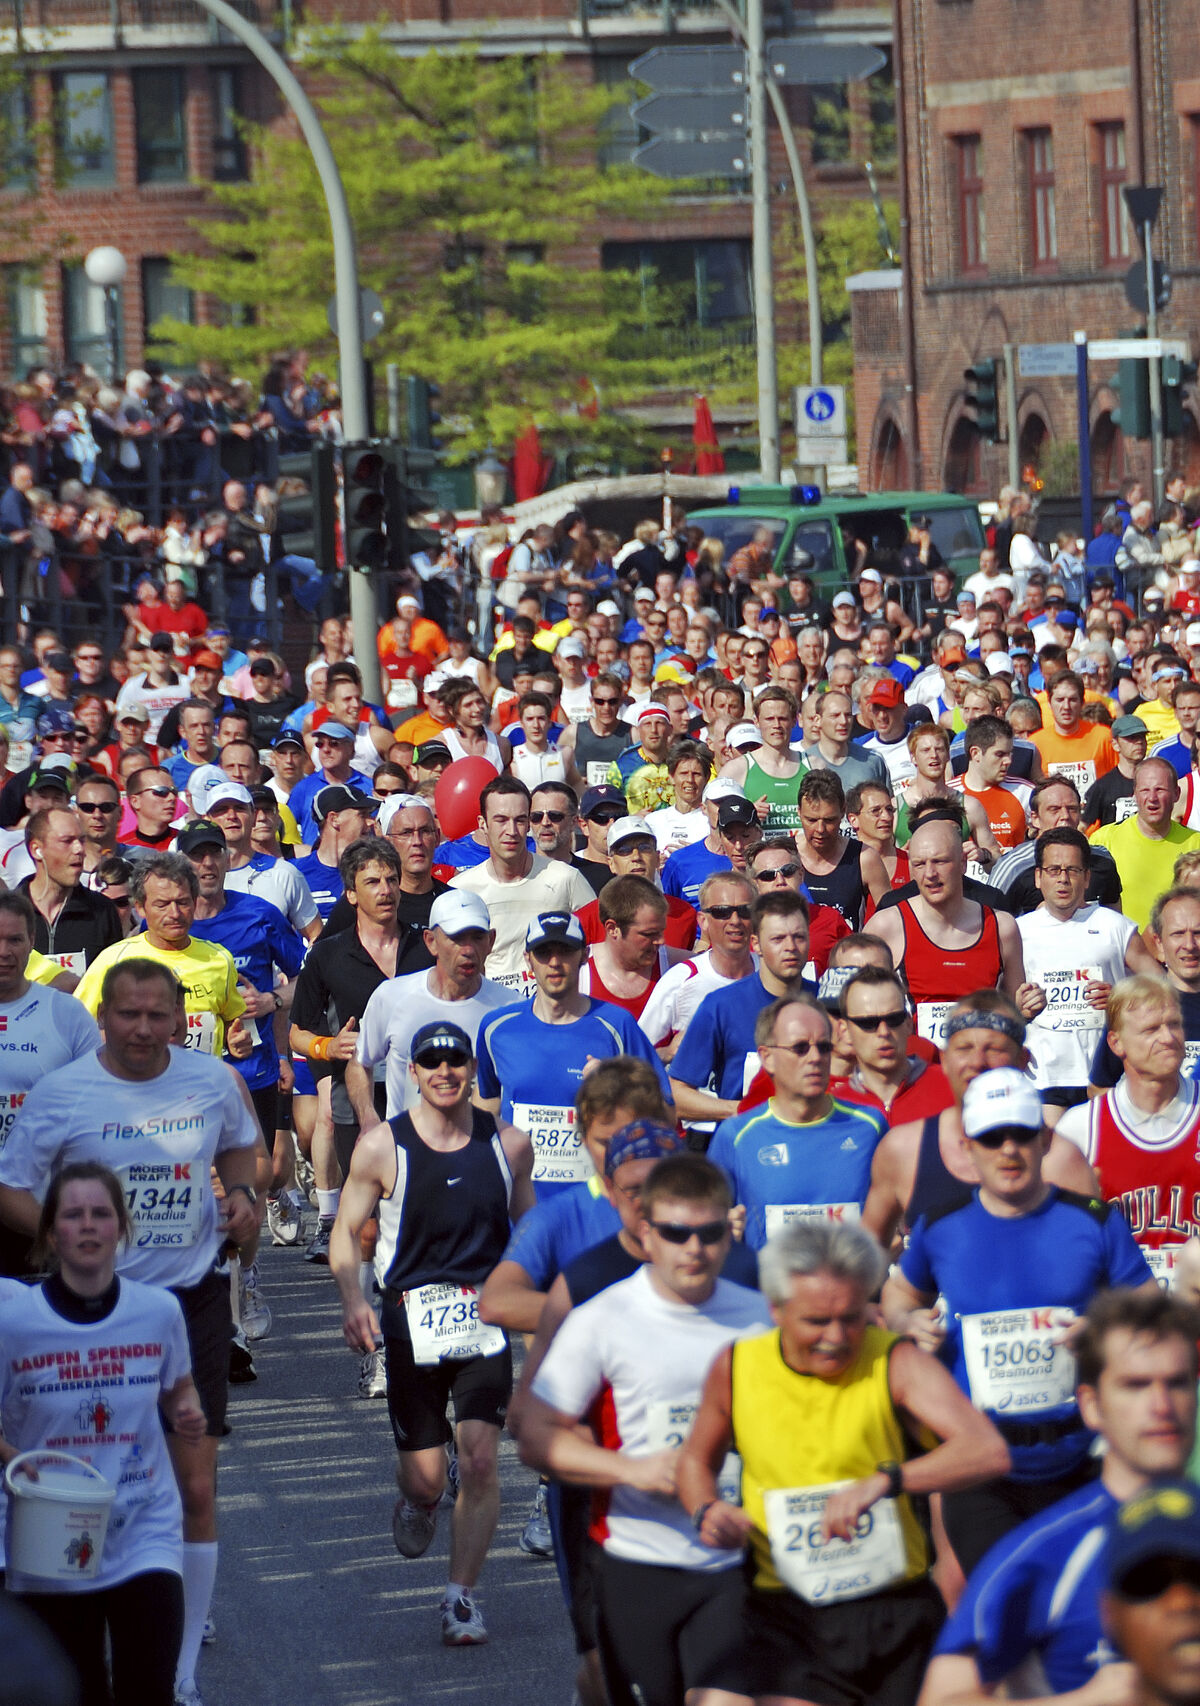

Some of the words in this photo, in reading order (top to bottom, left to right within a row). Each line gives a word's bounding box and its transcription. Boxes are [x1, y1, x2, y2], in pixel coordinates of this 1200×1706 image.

[769, 803, 799, 813] Team
[1047, 1003, 1089, 1012] Domingo
[102, 1114, 205, 1140] FlexStrom
[129, 1173, 171, 1182] KRAFT
[126, 1186, 192, 1210] 1344
[132, 1210, 186, 1222] Arkadius
[152, 1233, 183, 1245] asics
[420, 1290, 458, 1305] KRAFT
[420, 1300, 480, 1329] 4738
[434, 1320, 477, 1338] Michael
[981, 1322, 1026, 1337] KRAFT
[12, 1350, 80, 1373] LAUFEN
[88, 1343, 162, 1362] SPENDEN
[980, 1338, 1056, 1368] 15063
[58, 1362, 125, 1380] HELFEN
[785, 1509, 875, 1552] 269
